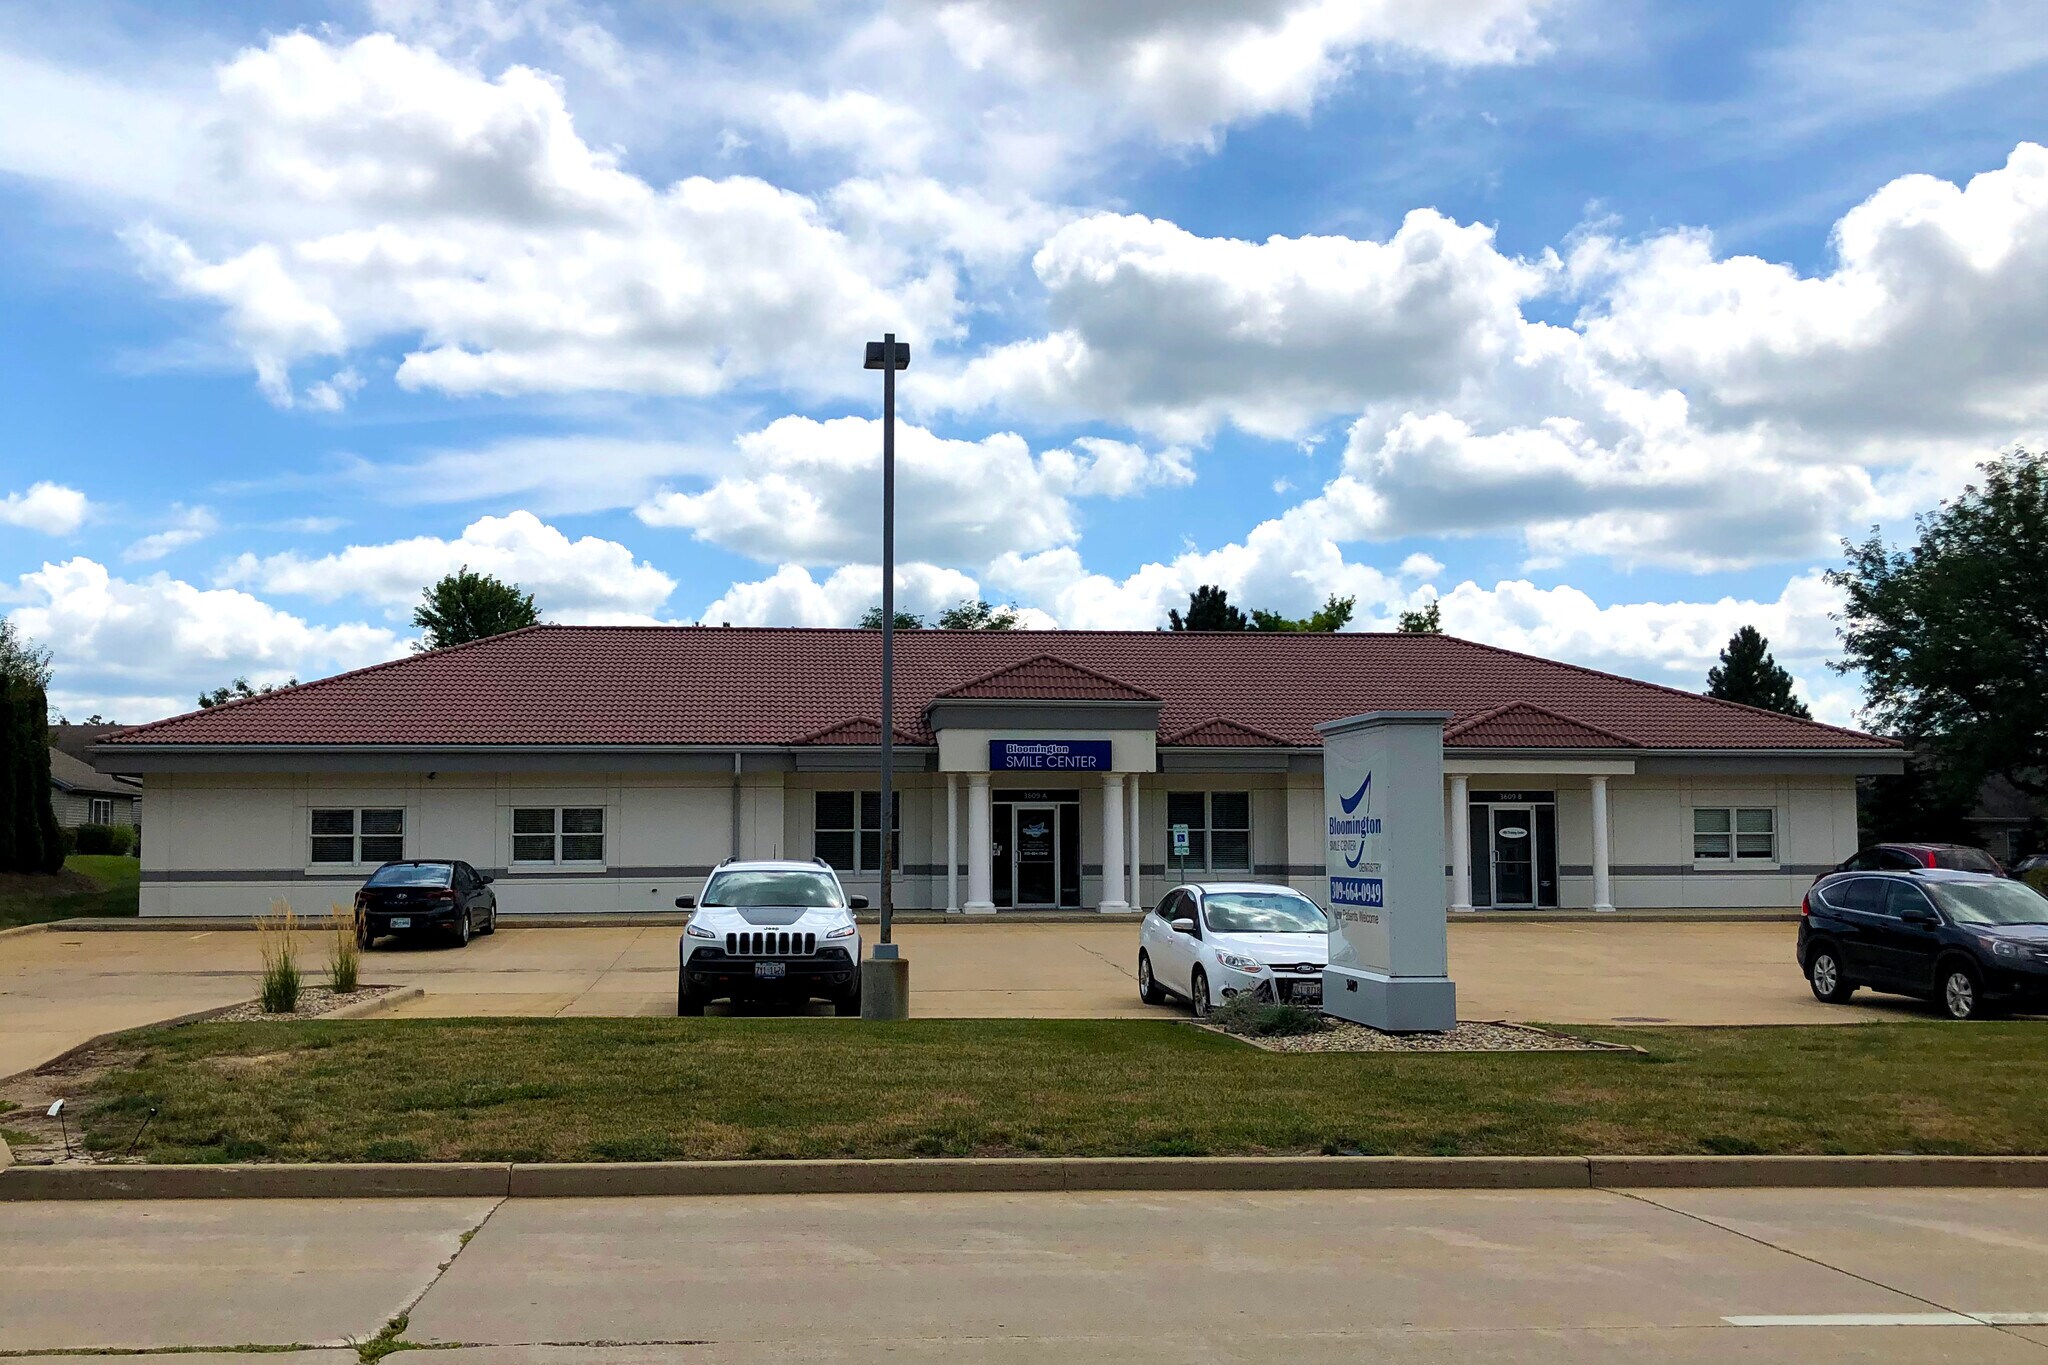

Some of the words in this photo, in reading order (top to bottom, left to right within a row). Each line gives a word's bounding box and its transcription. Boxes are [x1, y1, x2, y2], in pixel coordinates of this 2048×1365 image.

[1006, 743, 1069, 755] Bloomington
[1006, 755, 1043, 768] SMILE
[1046, 755, 1097, 768] CENTER
[1329, 816, 1381, 839] Bloomington
[1329, 840, 1340, 851] SMILE
[1341, 839, 1357, 851] CENTER
[1359, 862, 1382, 873] DENTISTRY
[1331, 881, 1381, 903] 309-664-0949
[1343, 909, 1358, 922] Patients
[1359, 911, 1379, 924] Welcome
